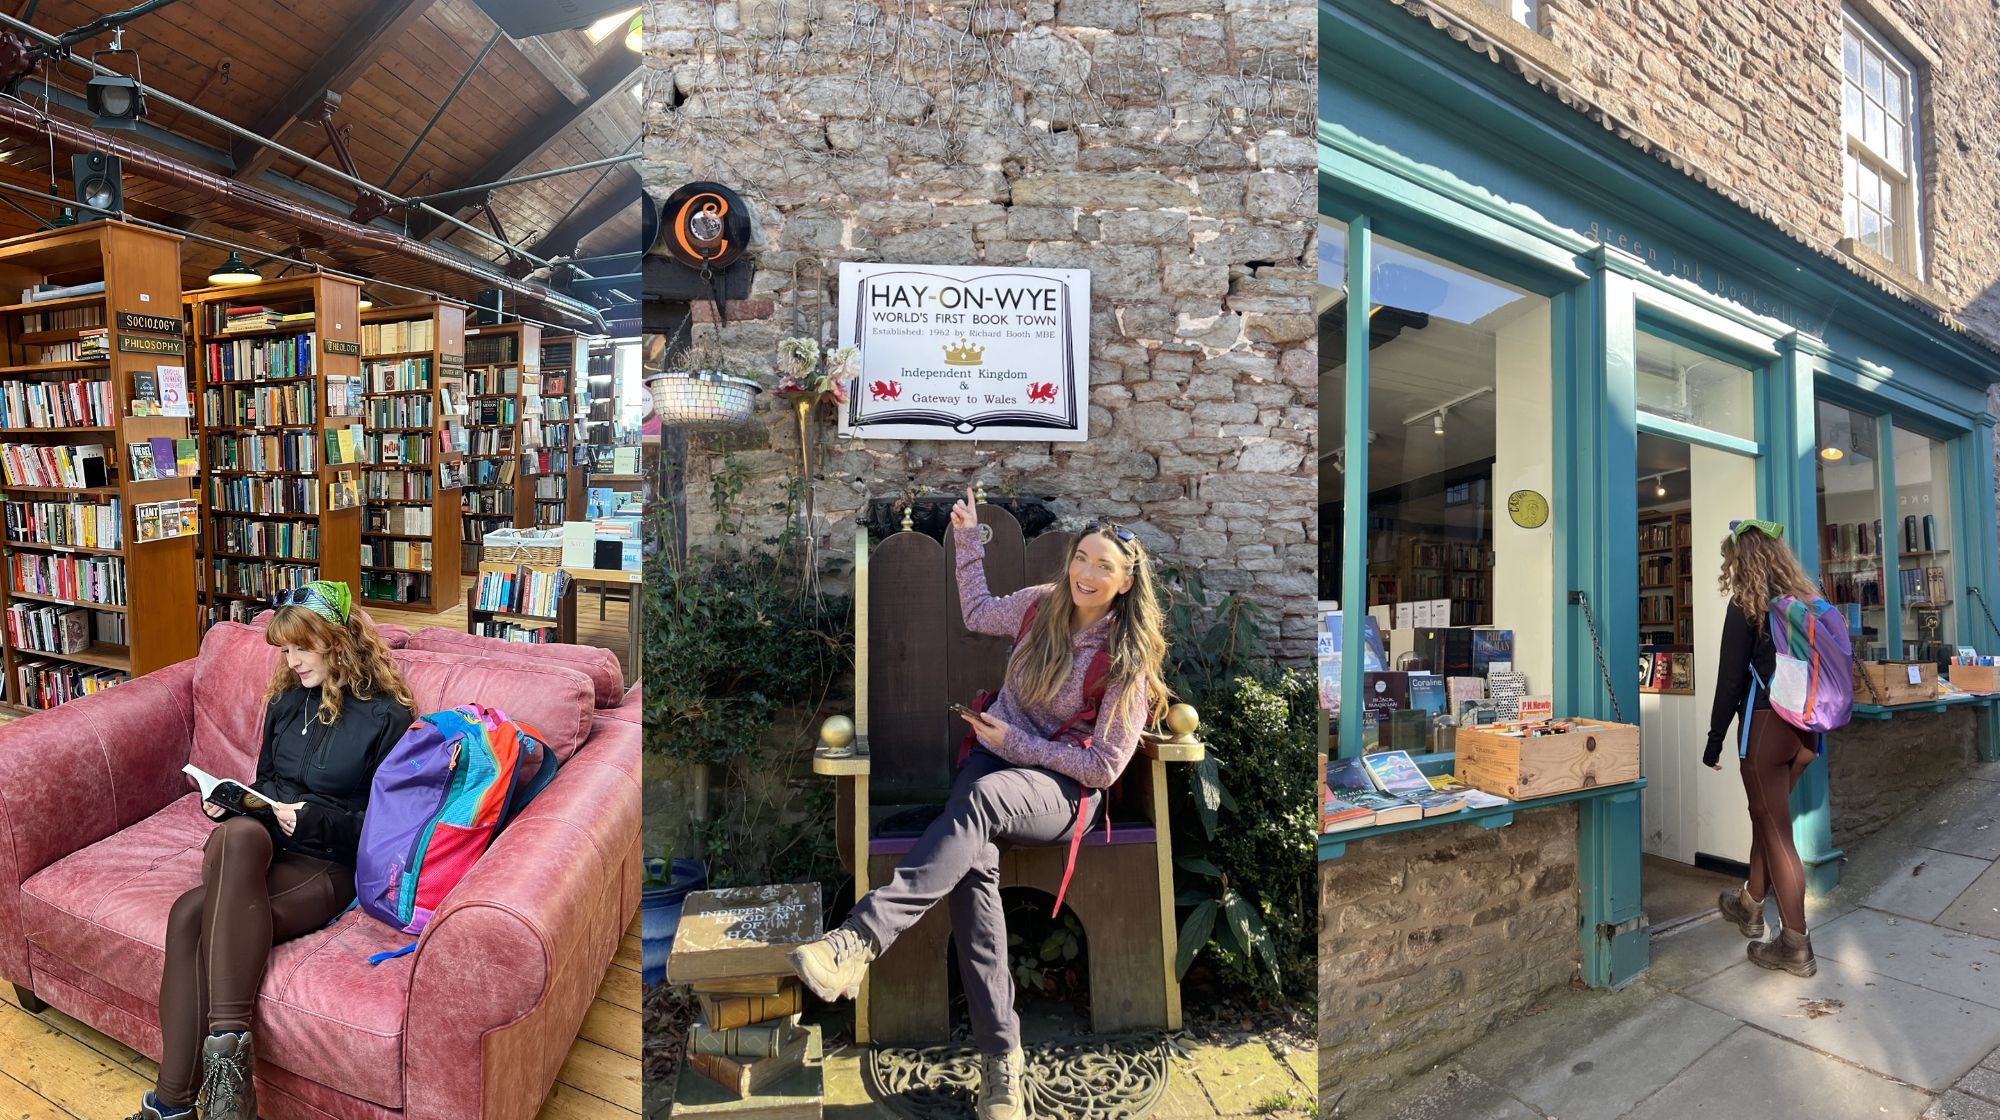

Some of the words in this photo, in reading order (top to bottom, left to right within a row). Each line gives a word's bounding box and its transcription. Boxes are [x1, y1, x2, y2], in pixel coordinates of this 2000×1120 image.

[1583, 221, 1657, 262] green
[1672, 257, 1703, 284] ink
[871, 284, 1057, 311] HAY-ON-WYE
[126, 314, 176, 332] SOCIOLOGY
[873, 312, 929, 324] WORLD'S
[935, 313, 966, 325] FIRST
[973, 314, 1009, 326] BOOK
[1015, 315, 1057, 327] TOWN
[872, 327, 925, 337] Established:
[929, 329, 950, 338] 1962
[955, 329, 966, 339] by
[969, 329, 1002, 339] Richard
[1006, 331, 1031, 339] Booth
[1036, 331, 1056, 339] MBE
[124, 338, 180, 352] PHILOSOPHY
[328, 341, 359, 353] THEOLOGY
[901, 368, 972, 380] Independent
[978, 369, 1028, 382] Kingdom
[960, 381, 969, 390] &
[912, 393, 960, 406] Gateway
[967, 395, 978, 405] to
[984, 395, 1017, 405] Wales
[134, 446, 152, 456] HEGEL
[140, 508, 159, 518] KANT
[1412, 678, 1443, 687] Coraline
[700, 904, 807, 919] INDEPENENT
[715, 913, 790, 925] KINGDM
[741, 922, 761, 931] OF
